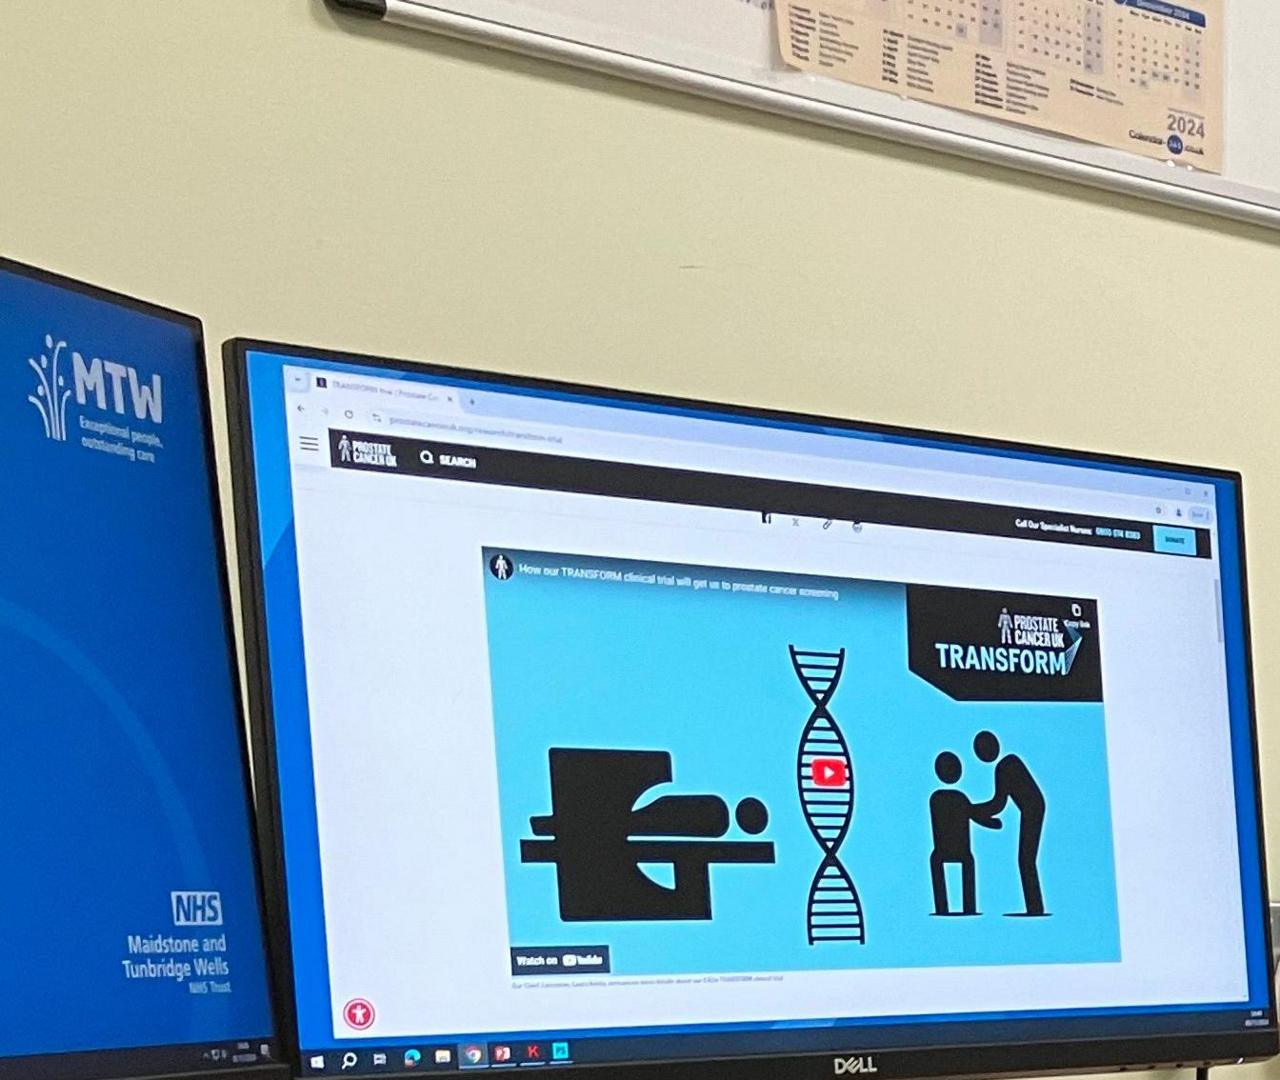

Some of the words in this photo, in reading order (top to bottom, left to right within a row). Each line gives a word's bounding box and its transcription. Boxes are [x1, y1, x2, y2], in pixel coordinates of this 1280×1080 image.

[1167, 113, 1205, 139] 2024
[72, 352, 163, 424] MTW
[439, 454, 477, 469] SEARCH
[1015, 518, 1028, 528] Call
[518, 563, 541, 576] How
[543, 567, 559, 576] our
[561, 567, 622, 582] TRANSFORM
[624, 573, 656, 584] clinical
[657, 574, 675, 586] trial
[675, 576, 691, 587] will
[693, 578, 708, 590] get
[709, 580, 720, 589] us
[721, 580, 731, 590] to
[732, 582, 768, 594] prostate
[769, 585, 797, 595] cancer
[799, 588, 839, 601] screening
[1013, 615, 1059, 632] PROSTATE
[1014, 630, 1051, 647] CANCER
[1051, 632, 1065, 648] UK
[935, 643, 1067, 676] TRANSFORM
[174, 893, 220, 924] NHS
[128, 934, 199, 954] Maidstone
[202, 934, 227, 952] and
[122, 958, 191, 982] Tunbridge
[193, 957, 230, 976] Wells
[516, 954, 545, 966] Watch
[545, 955, 558, 965] on
[834, 1056, 878, 1075] DELL
